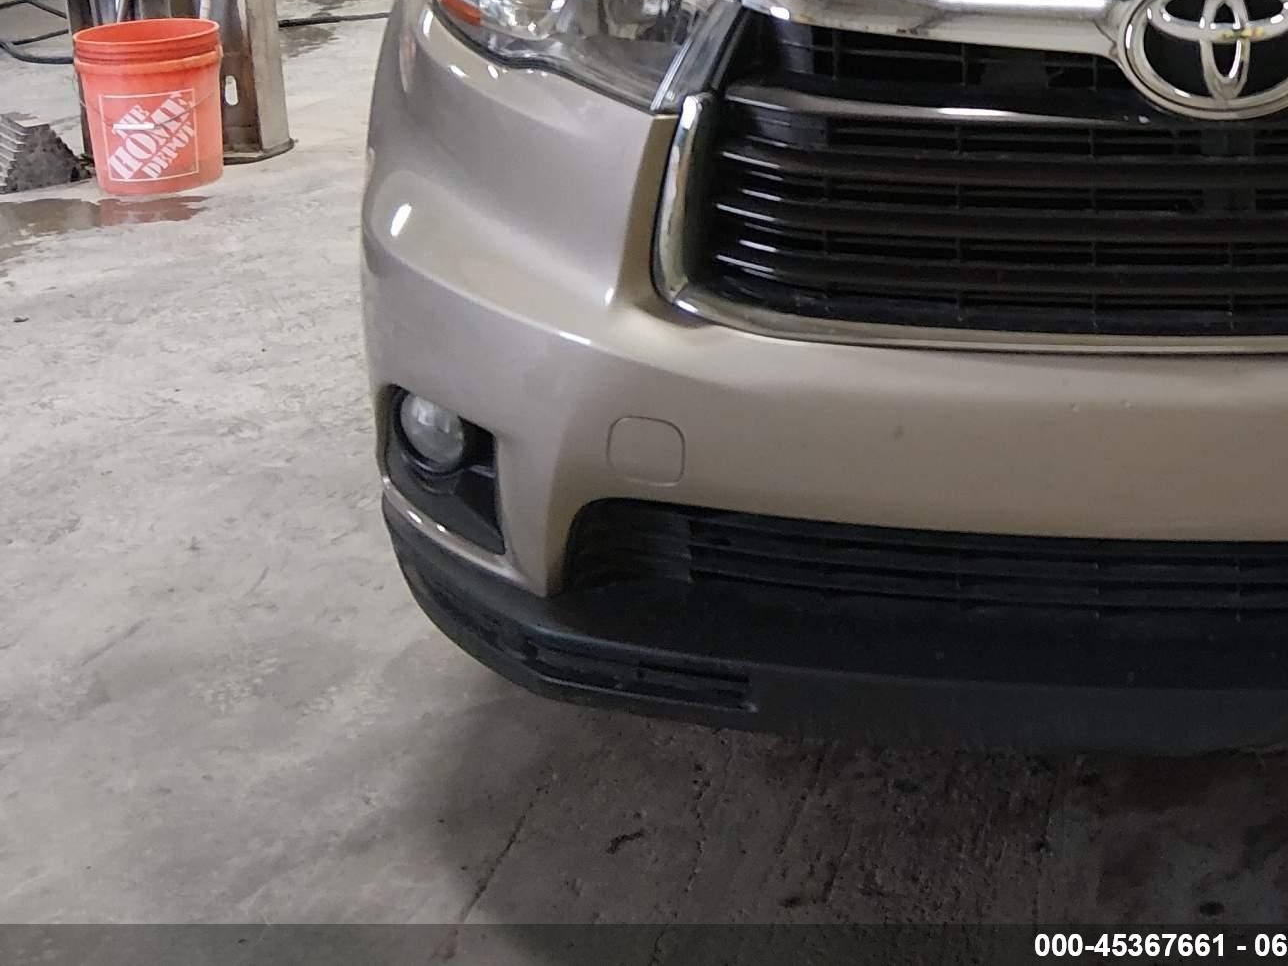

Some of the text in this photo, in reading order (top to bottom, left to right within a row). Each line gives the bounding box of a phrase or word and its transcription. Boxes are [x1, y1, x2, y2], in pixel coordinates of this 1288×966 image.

[110, 93, 193, 180] HOME
[112, 104, 150, 139] THE
[141, 121, 194, 178] DEPOT
